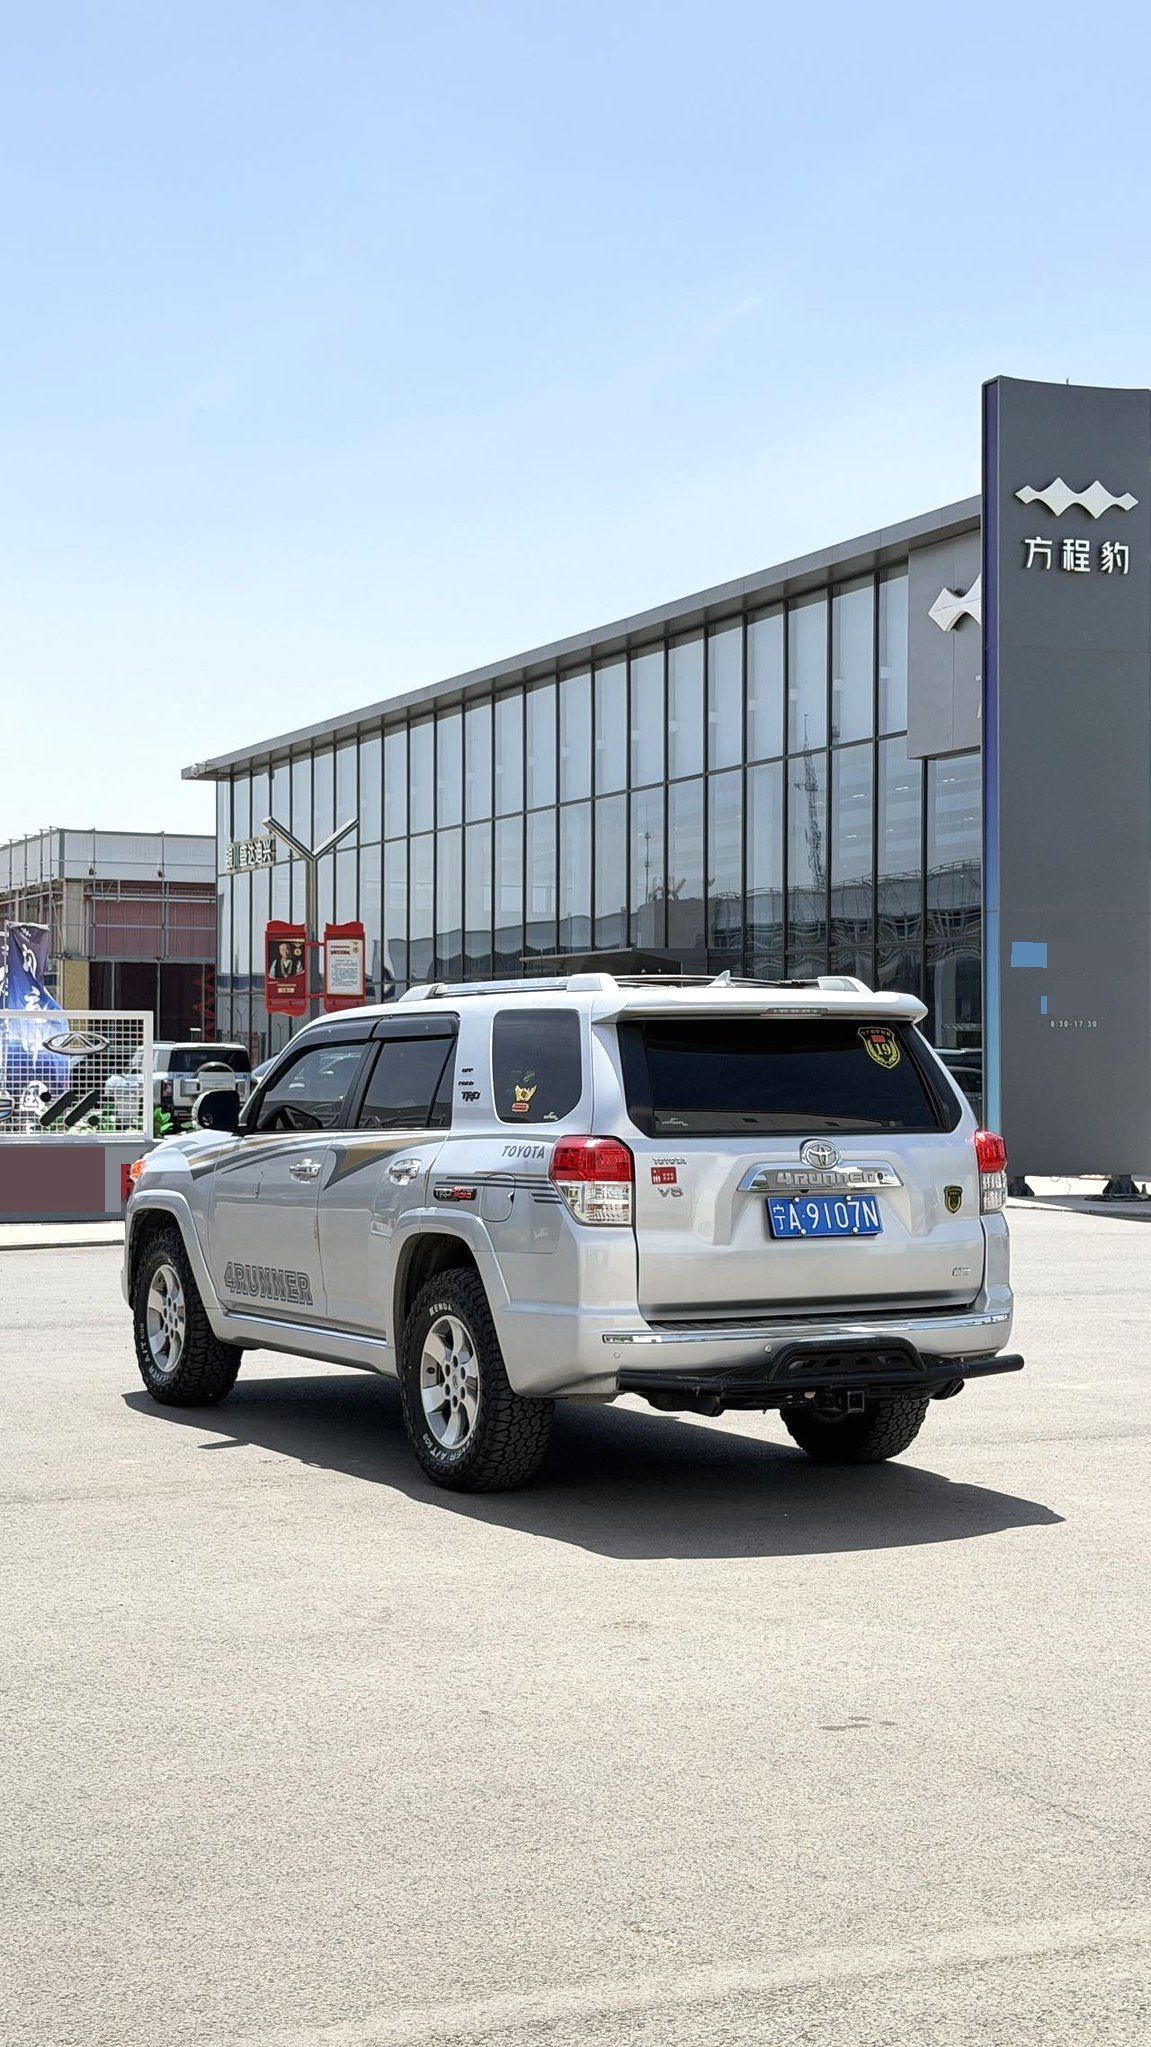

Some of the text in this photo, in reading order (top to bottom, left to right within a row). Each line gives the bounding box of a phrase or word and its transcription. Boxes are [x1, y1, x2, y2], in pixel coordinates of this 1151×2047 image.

[1025, 536, 1129, 575] 方程豹
[873, 1043, 892, 1056] 19
[461, 1091, 481, 1102] TRD
[501, 1145, 545, 1159] TOYOTA
[652, 1157, 687, 1166] TOYOTA
[657, 1187, 684, 1198] V6
[224, 1261, 314, 1306] 4RUNNER
[429, 1302, 452, 1316] KENDA
